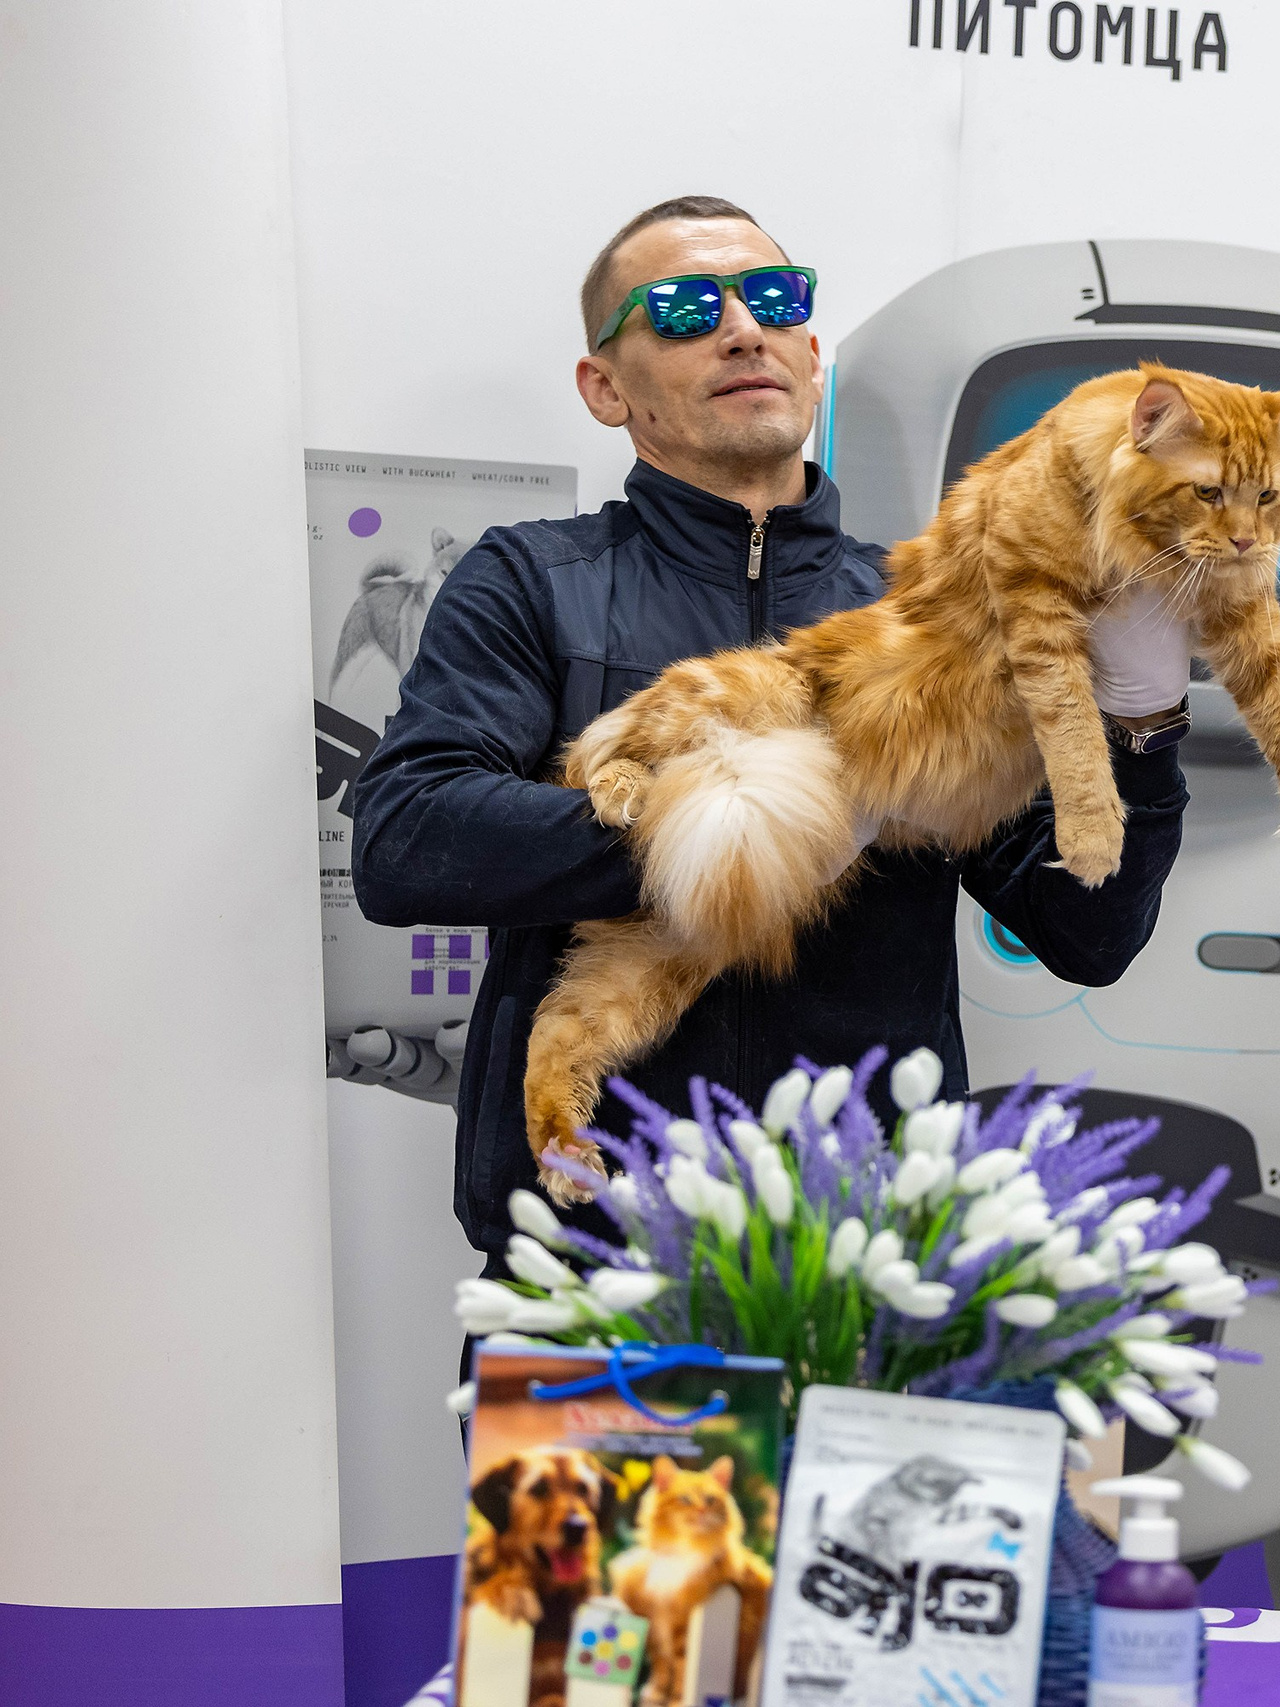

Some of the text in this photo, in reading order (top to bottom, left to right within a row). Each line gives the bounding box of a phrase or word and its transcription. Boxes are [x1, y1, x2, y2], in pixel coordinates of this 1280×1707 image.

[909, 0, 1228, 81] ПИТОМЦА
[345, 464, 367, 473] VIEW
[382, 467, 404, 476] WITH
[409, 468, 456, 479] BUCKWHEAT
[472, 473, 524, 483] WHEAT/CORN
[530, 476, 550, 486] FREE
[319, 831, 345, 842] LINE
